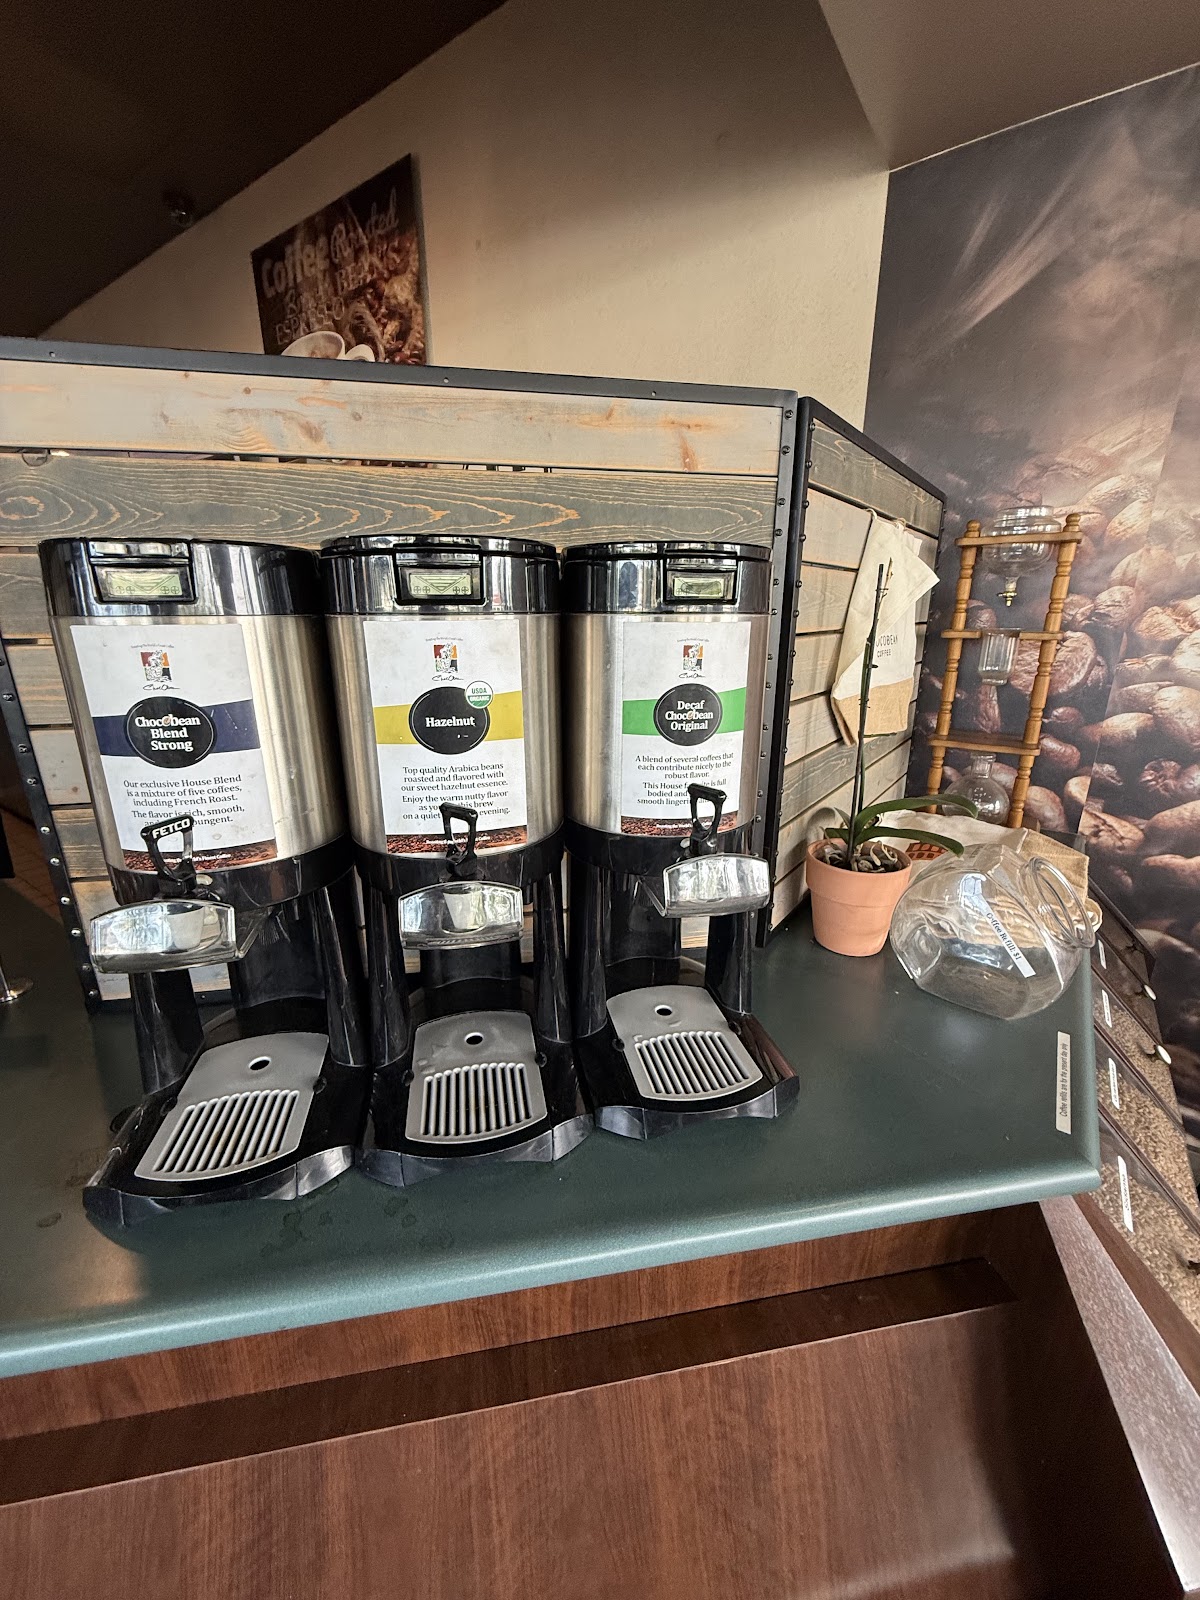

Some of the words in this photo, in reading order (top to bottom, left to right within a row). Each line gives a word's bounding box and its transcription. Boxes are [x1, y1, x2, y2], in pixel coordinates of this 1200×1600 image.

[261, 232, 330, 299] Coffee
[677, 700, 706, 710] Decaf
[426, 716, 476, 728] Hazelnut
[670, 720, 708, 732] Original
[150, 727, 188, 738] Blend
[150, 740, 194, 752] Strong
[402, 766, 418, 775] Top
[420, 766, 447, 776] quality
[448, 764, 479, 773] Arabica
[695, 762, 714, 770] nicely
[214, 774, 242, 784] Blend
[452, 772, 484, 781] flavored
[486, 770, 504, 778] with
[178, 788, 186, 796] of
[207, 786, 242, 794] coffees,
[441, 782, 476, 790] hazelnut
[476, 780, 508, 788] essence.
[133, 798, 174, 808] including
[174, 796, 206, 806] French
[209, 794, 238, 803] Roast.
[402, 796, 424, 804] Enjoy
[486, 790, 508, 798] flavor
[206, 804, 244, 815] smooth,
[420, 812, 440, 820] quiet
[479, 806, 510, 816] evening.
[152, 818, 191, 839] FETCO
[986, 912, 1002, 932] Coffee
[1059, 1102, 1068, 1117] Coffee
